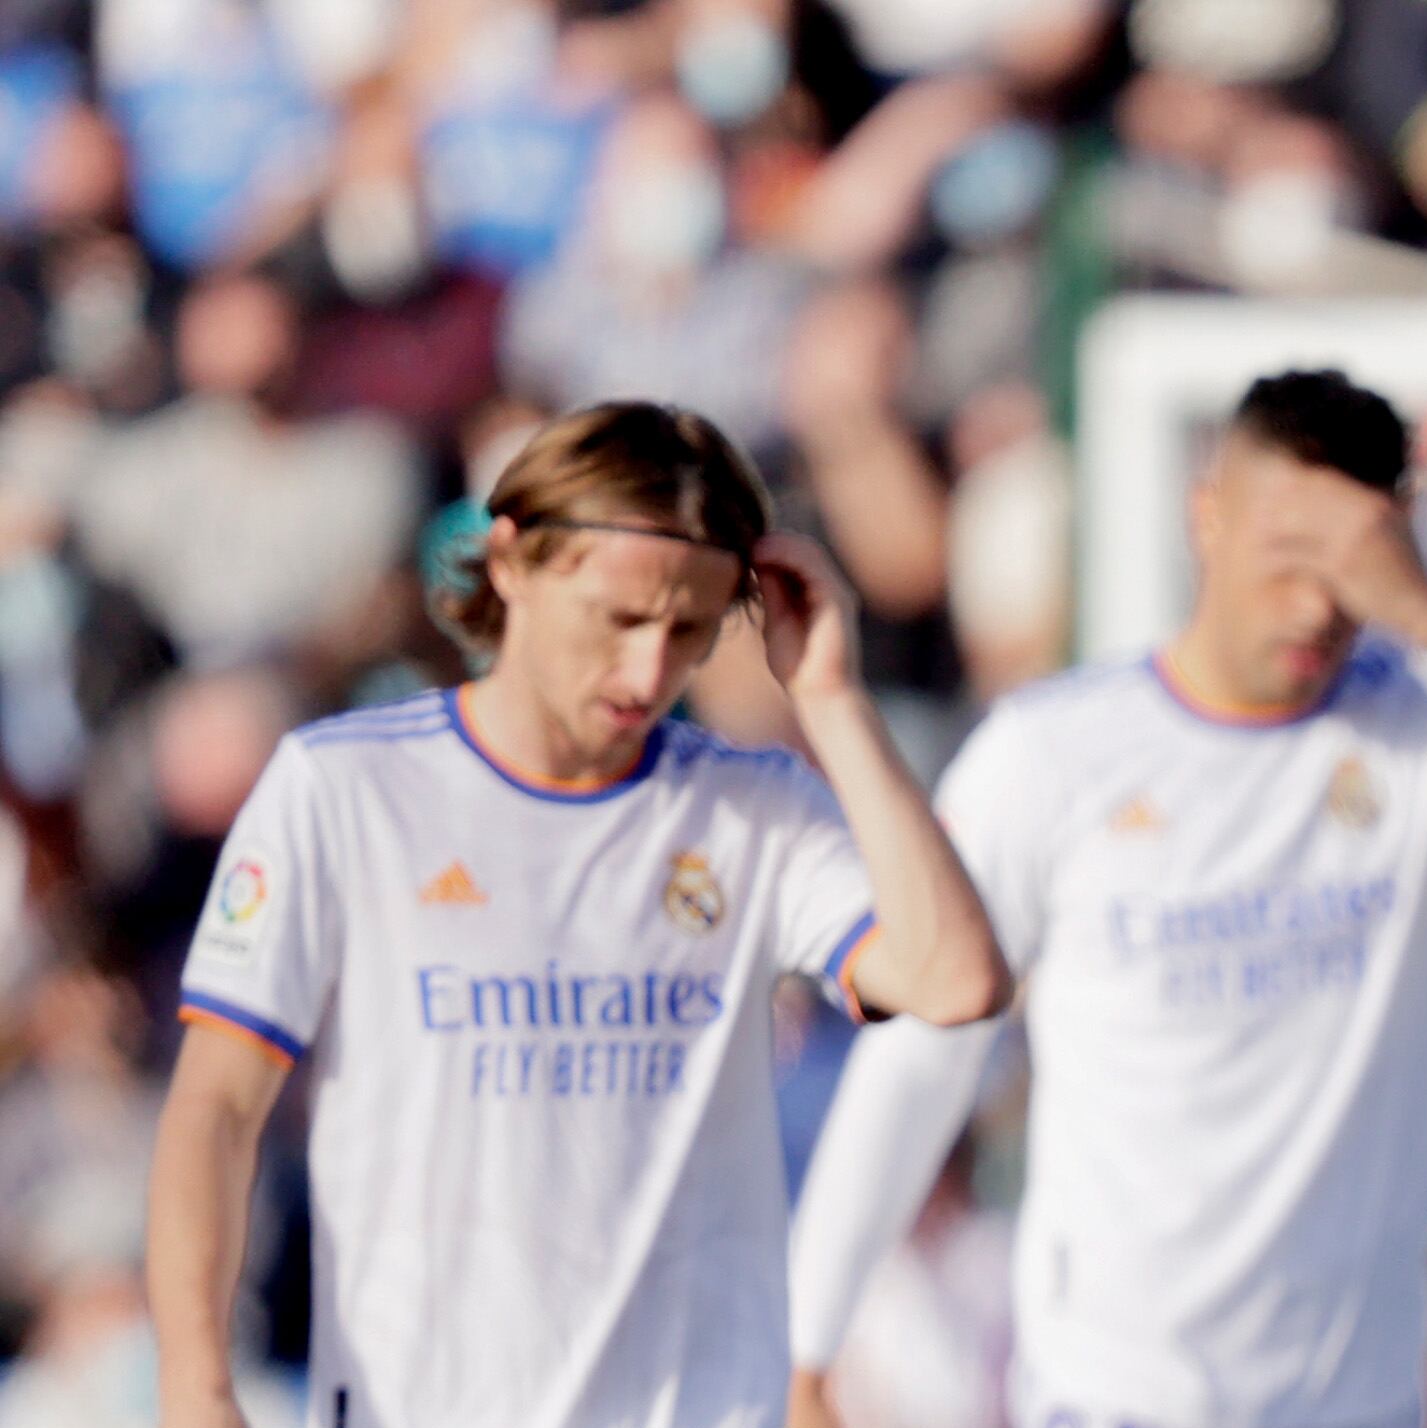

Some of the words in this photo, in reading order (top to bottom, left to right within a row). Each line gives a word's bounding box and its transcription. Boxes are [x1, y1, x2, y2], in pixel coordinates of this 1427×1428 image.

[417, 959, 725, 1031] Emirates
[471, 1041, 533, 1097] FLY
[554, 1041, 688, 1098] BETTER
